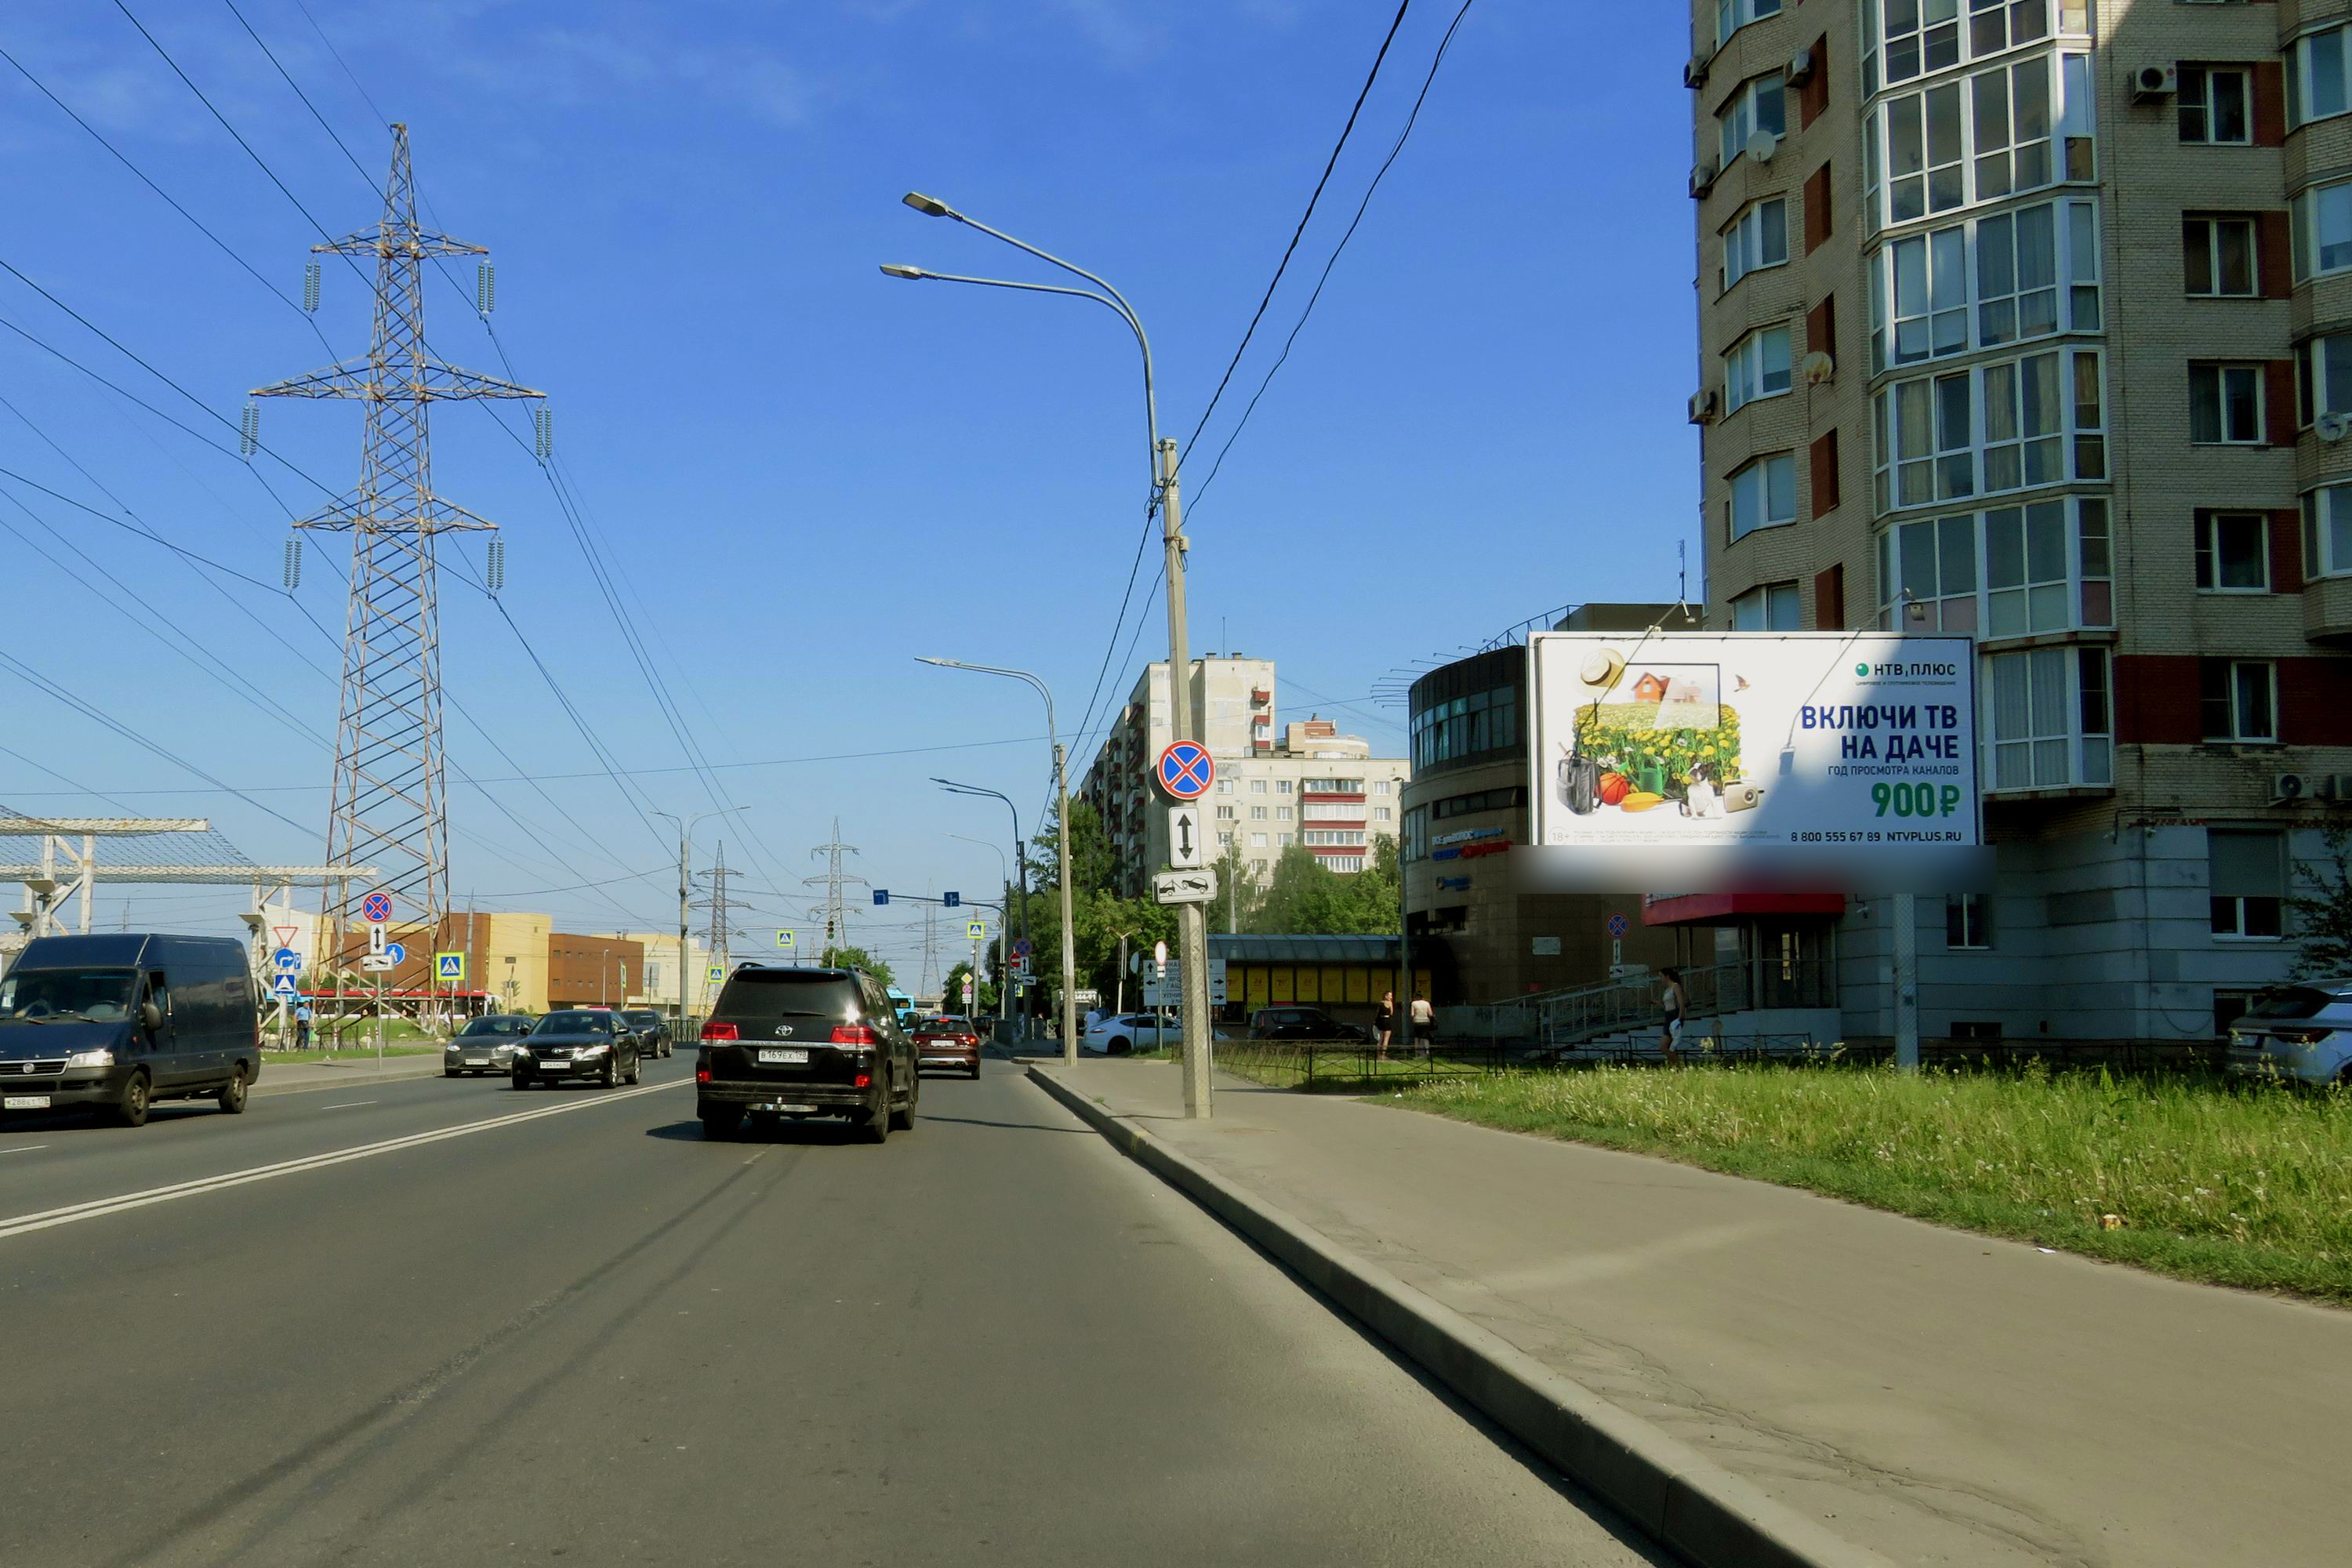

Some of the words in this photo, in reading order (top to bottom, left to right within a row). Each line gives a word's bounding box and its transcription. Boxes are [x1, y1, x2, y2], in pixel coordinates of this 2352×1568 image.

[1802, 706, 1916, 729] ВКЛЮЧИ
[1925, 706, 1958, 729] ТВ
[1842, 735, 1878, 759] НА
[1885, 735, 1959, 764] ДАЧЕ
[1828, 766, 1848, 776] ГОД
[1851, 765, 1909, 775] ПРОСМОТРА
[1912, 765, 1959, 775] КАНАЛОВ
[1552, 833, 1570, 842] 18+
[1791, 832, 1798, 842] 8
[1801, 832, 1822, 842] 800
[1825, 832, 1846, 842] 555
[1849, 832, 1864, 842] 67
[1867, 832, 1881, 842] 89
[1886, 832, 1962, 842] NTVPLUS.RU
